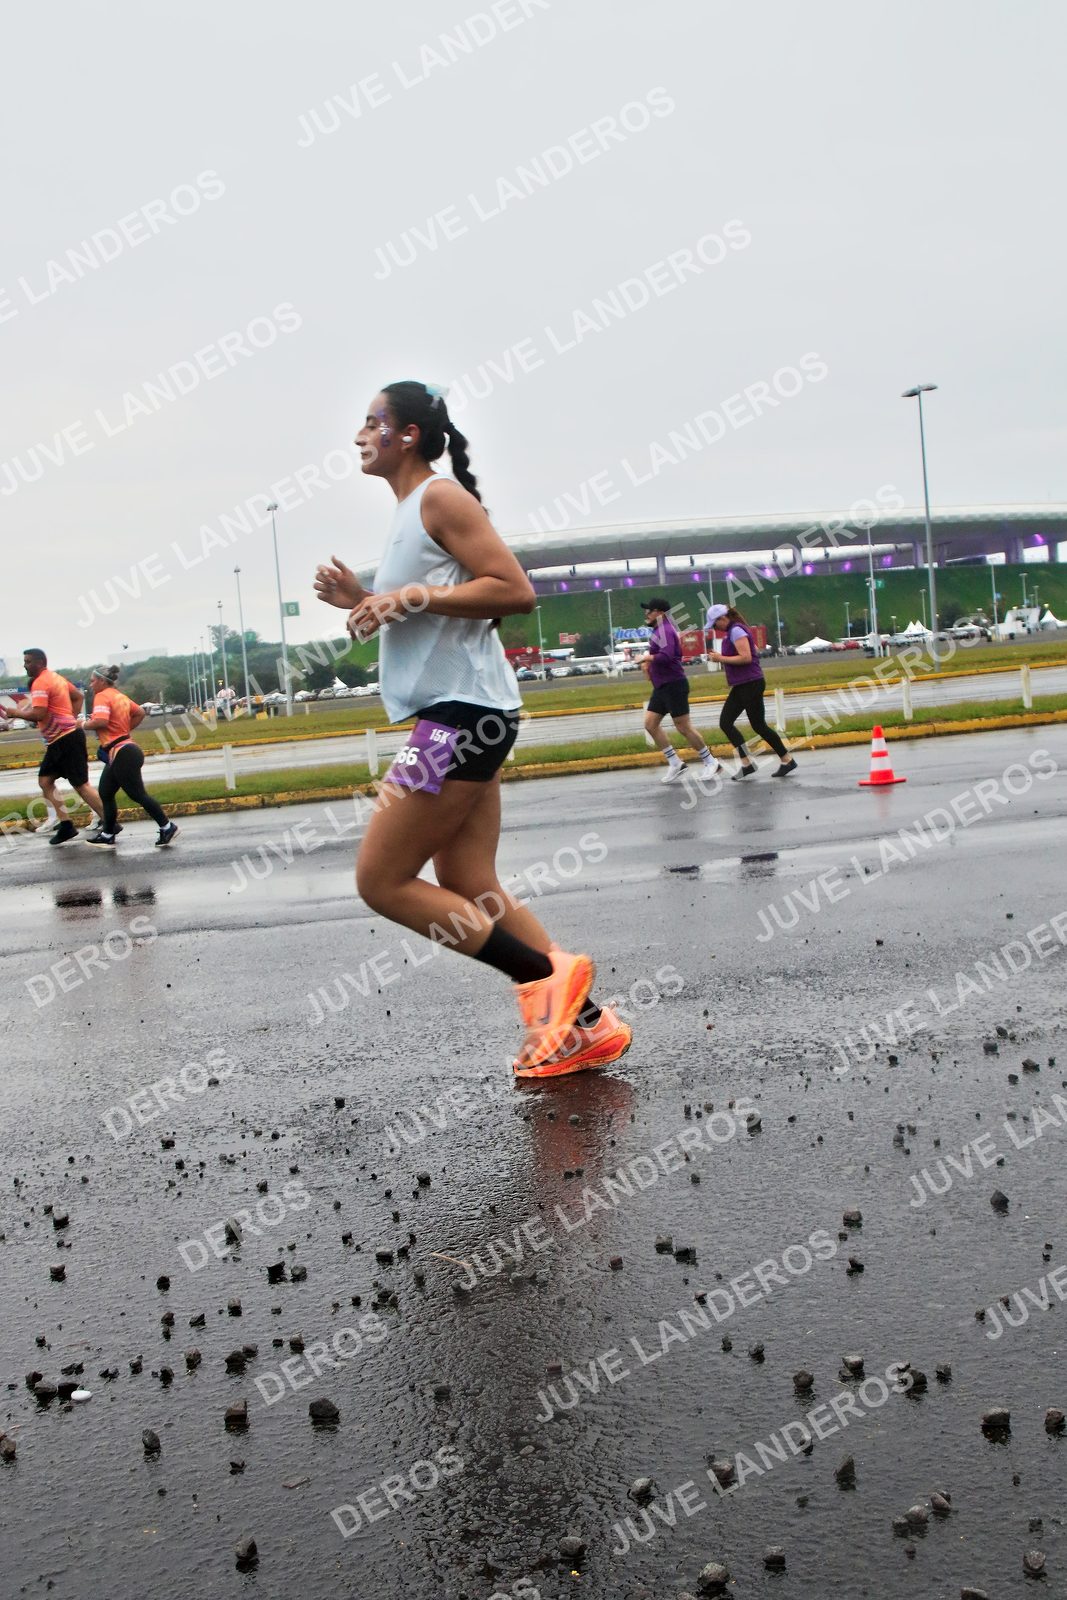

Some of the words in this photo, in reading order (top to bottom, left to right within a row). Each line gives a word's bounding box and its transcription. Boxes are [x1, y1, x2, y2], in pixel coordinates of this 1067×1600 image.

[288, 604, 297, 614] 8
[429, 728, 451, 744] 15K
[393, 746, 420, 766] 66
